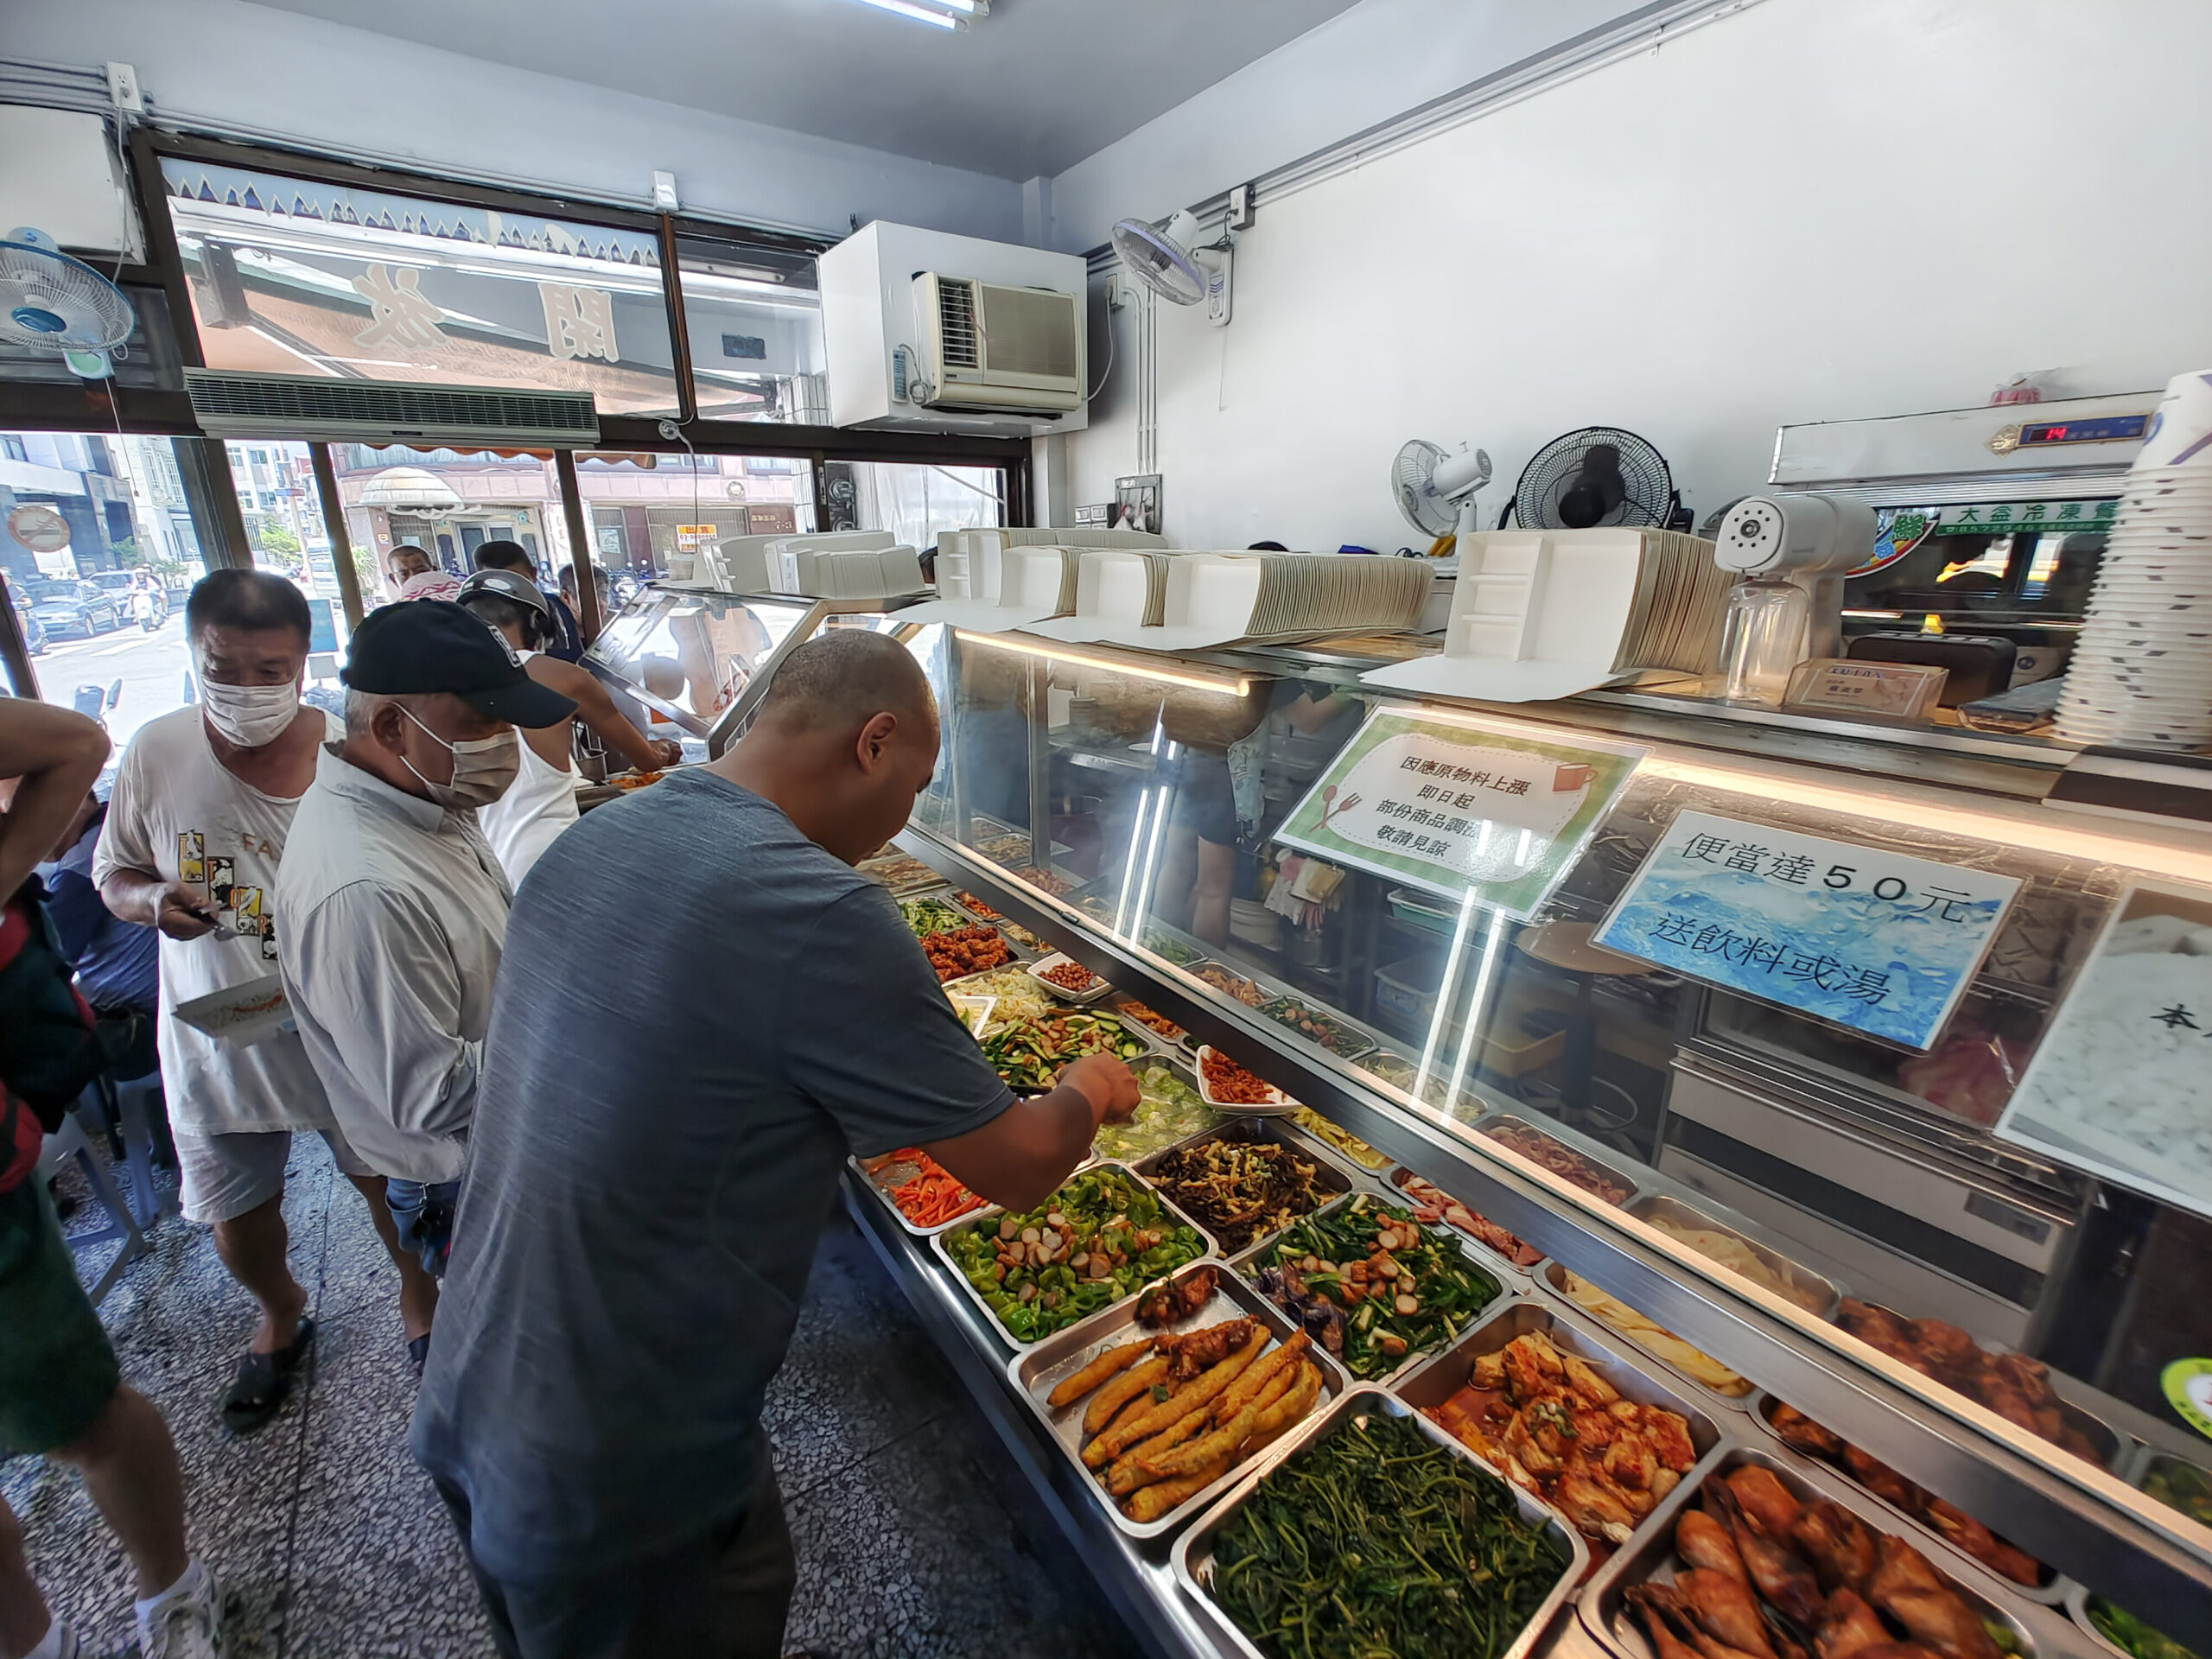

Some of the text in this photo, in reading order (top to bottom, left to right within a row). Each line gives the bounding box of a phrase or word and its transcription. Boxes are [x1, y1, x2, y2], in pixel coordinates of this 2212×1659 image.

[1400, 755, 1532, 797] 因應原物料上漲
[1416, 784, 1475, 810] 即日起
[1376, 823, 1452, 857] 敬請見諒
[1649, 911, 1892, 1005] 送飲料或湯
